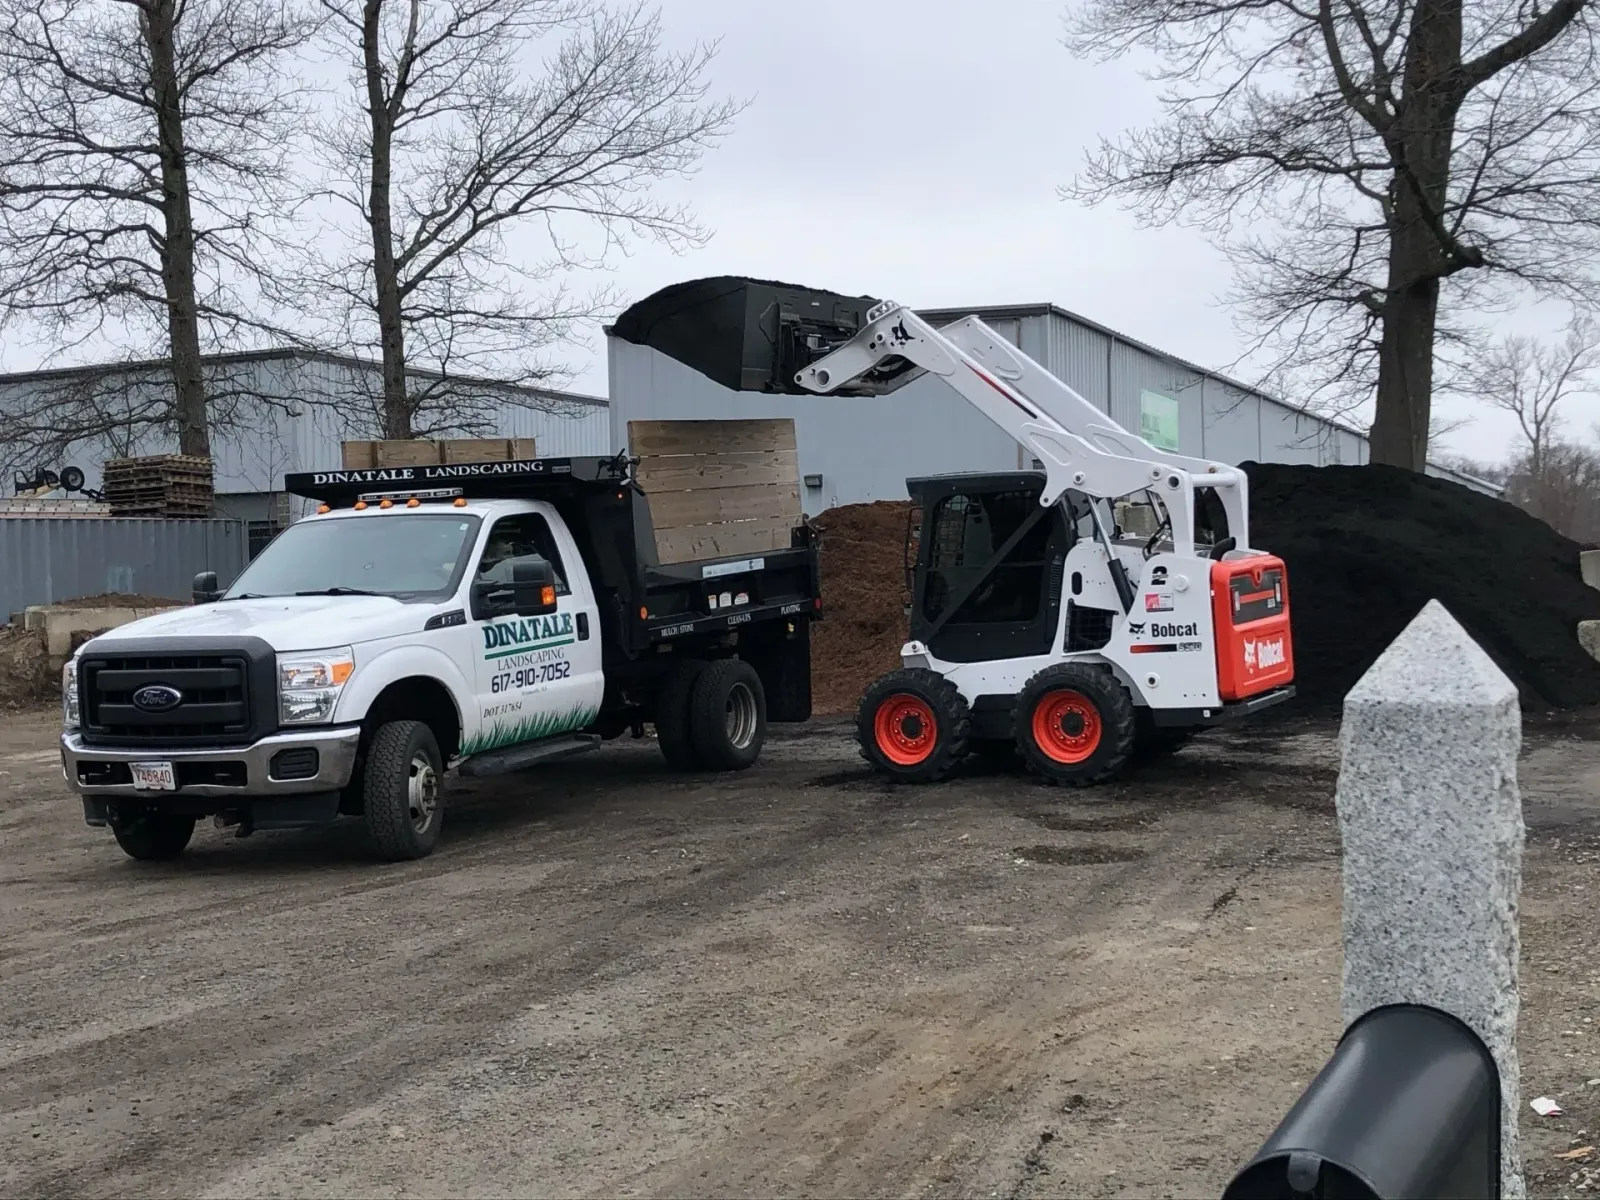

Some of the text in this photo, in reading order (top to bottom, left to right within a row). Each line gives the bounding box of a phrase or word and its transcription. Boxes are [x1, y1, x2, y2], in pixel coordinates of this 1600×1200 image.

[314, 469, 414, 485] DINATALE
[425, 461, 544, 478] LANDSCAPING
[482, 613, 573, 649] DINATALE
[661, 626, 678, 638] MULCH
[1151, 622, 1198, 637] Bobcat
[498, 647, 565, 671] LANDSCAPING
[1257, 637, 1285, 669] Bobcat
[491, 661, 571, 693] 617-910-7052
[141, 690, 168, 705] Ford
[483, 706, 500, 718] DOT
